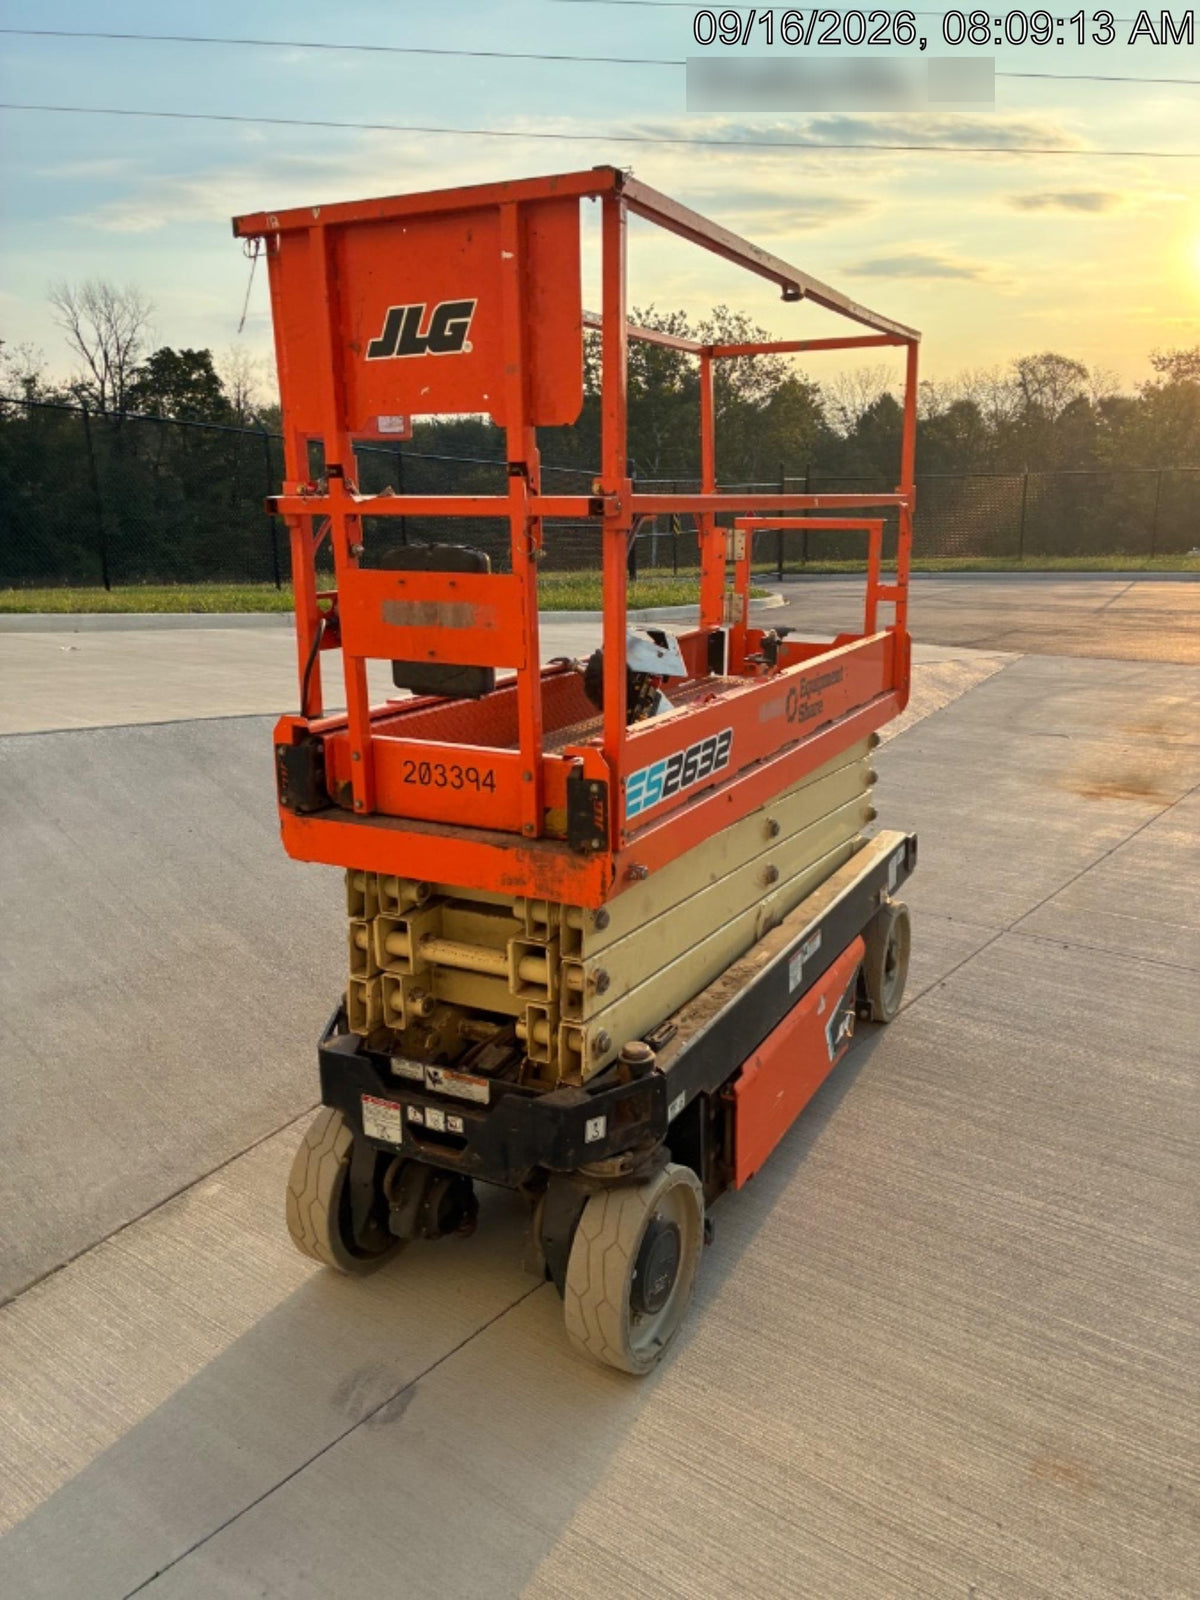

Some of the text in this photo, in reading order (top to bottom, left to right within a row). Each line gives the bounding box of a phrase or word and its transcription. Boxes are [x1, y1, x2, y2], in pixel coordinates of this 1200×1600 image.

[365, 299, 477, 360] JLG
[403, 760, 496, 793] 203394
[626, 728, 733, 820] ES2632
